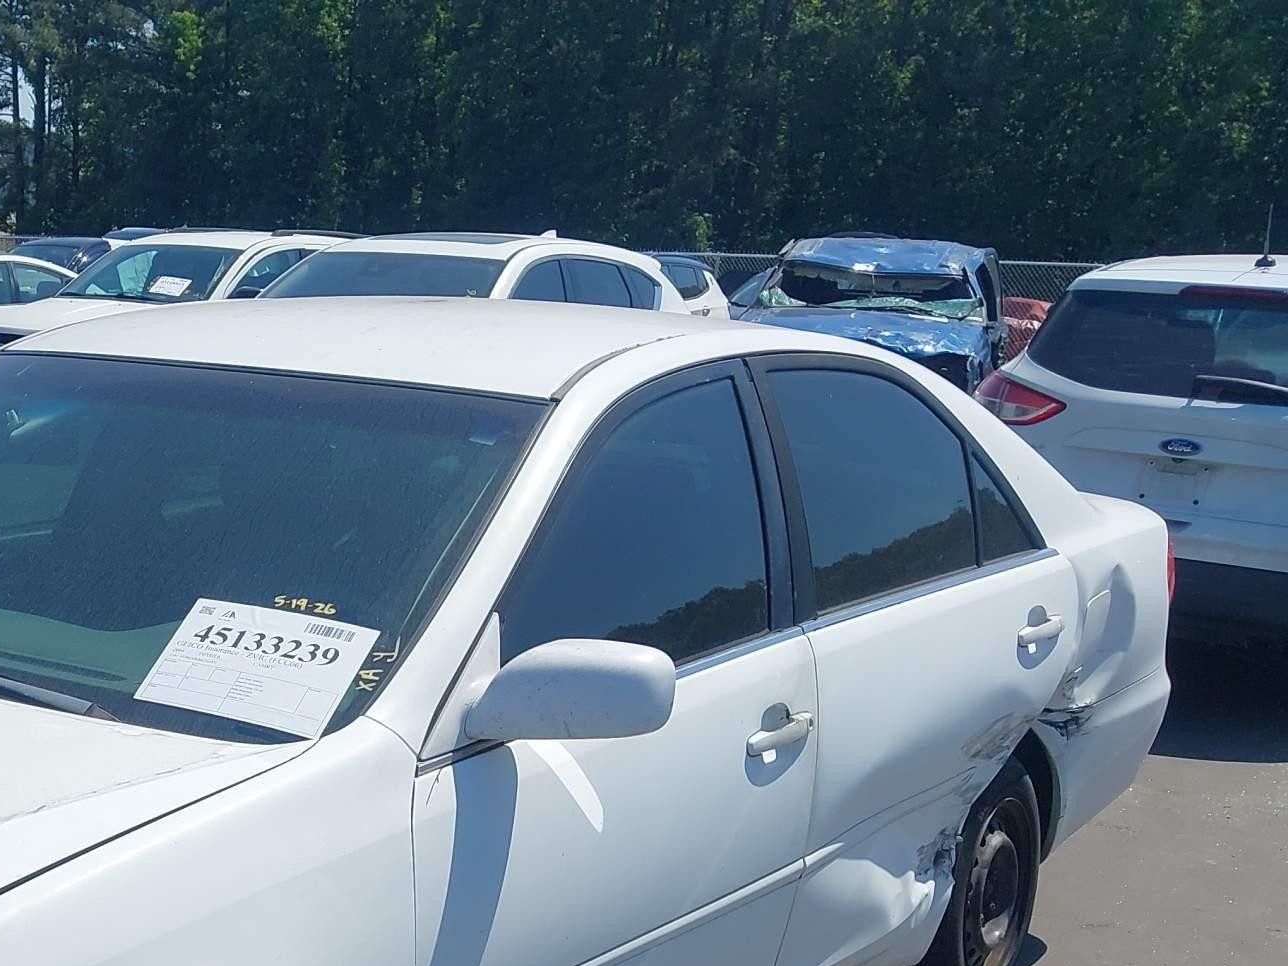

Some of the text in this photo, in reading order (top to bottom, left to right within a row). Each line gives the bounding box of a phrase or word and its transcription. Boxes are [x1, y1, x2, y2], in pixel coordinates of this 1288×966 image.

[274, 595, 337, 615] 5-19-26
[176, 640, 204, 650] GEICO
[193, 623, 341, 666] 45133239
